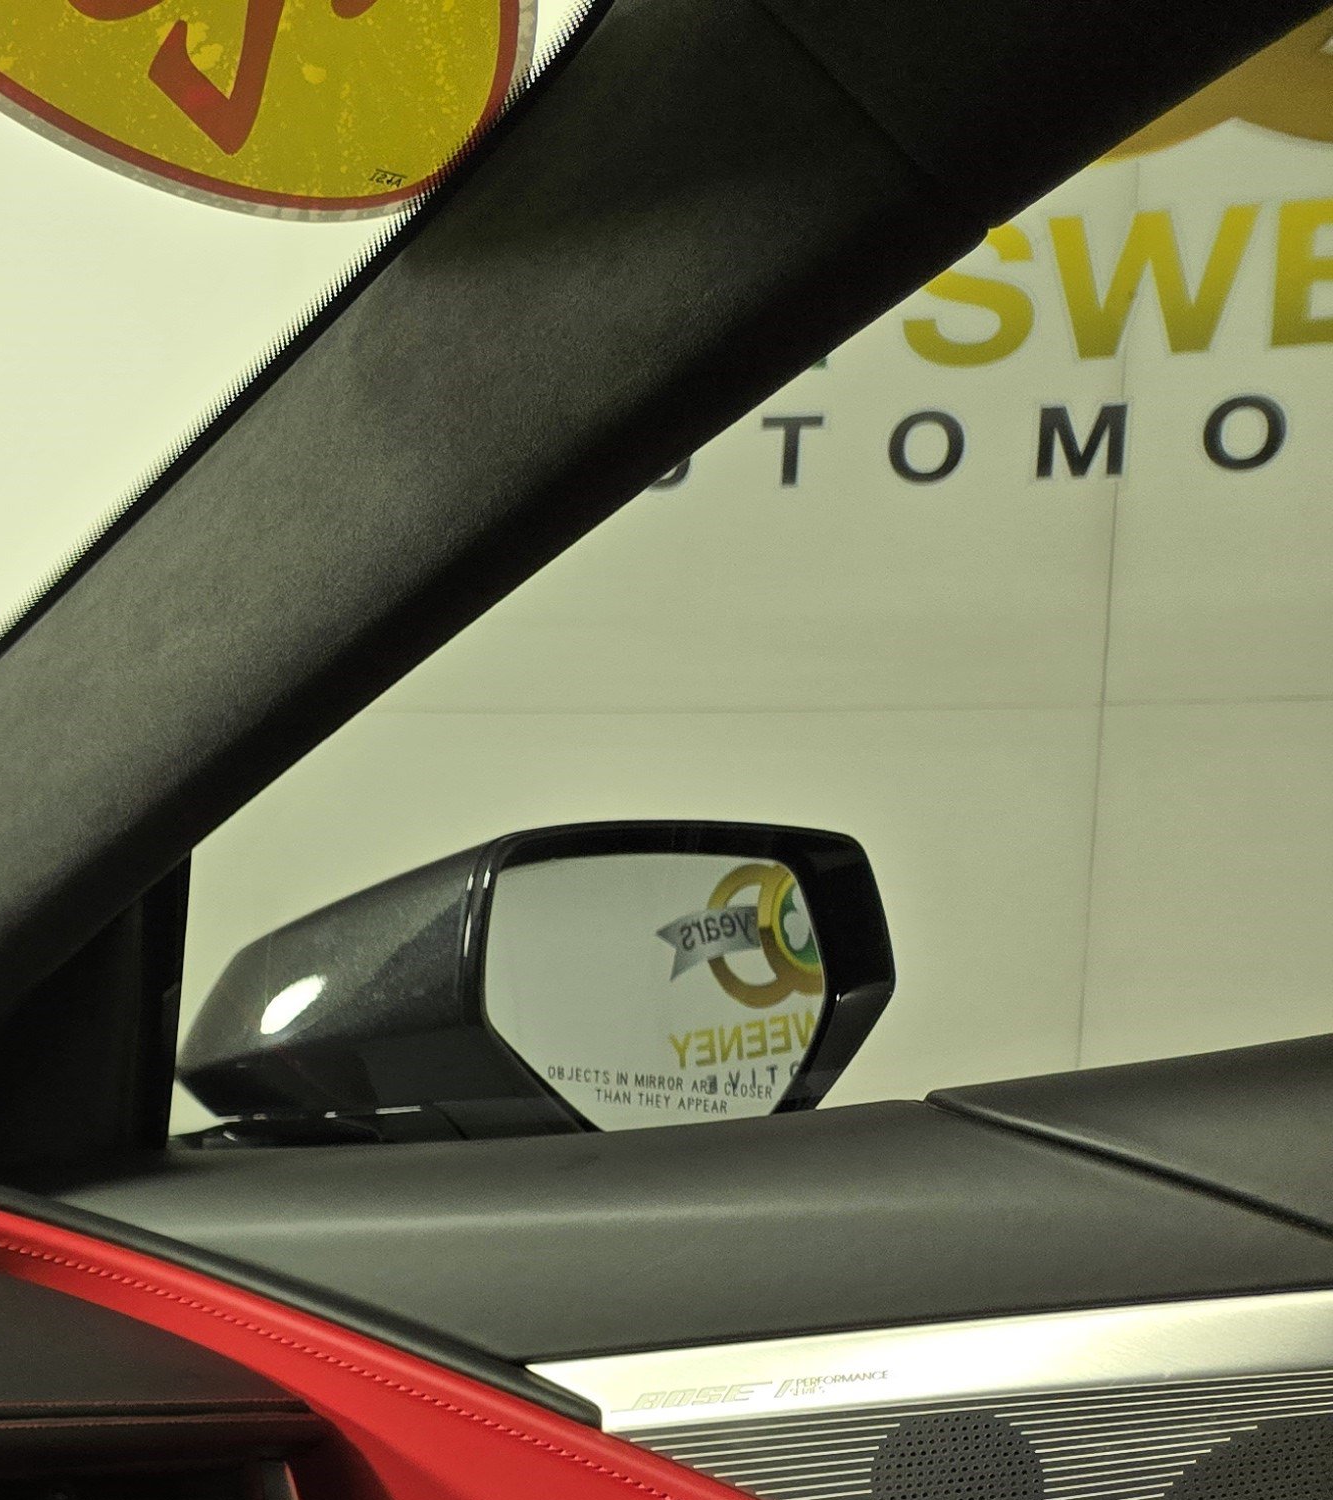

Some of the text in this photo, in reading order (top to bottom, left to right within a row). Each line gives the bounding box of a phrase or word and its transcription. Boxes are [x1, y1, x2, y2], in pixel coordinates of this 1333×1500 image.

[645, 394, 1287, 491] TOMO
[547, 1065, 610, 1084] OBJECTS
[616, 1072, 629, 1087] IN
[634, 1073, 683, 1091] MIRROR
[723, 1081, 773, 1100] CLOSER
[596, 1088, 728, 1115] THAN THEY APPEAR
[625, 1382, 772, 1411] BOSE
[794, 1370, 889, 1388] PERFORMANCE
